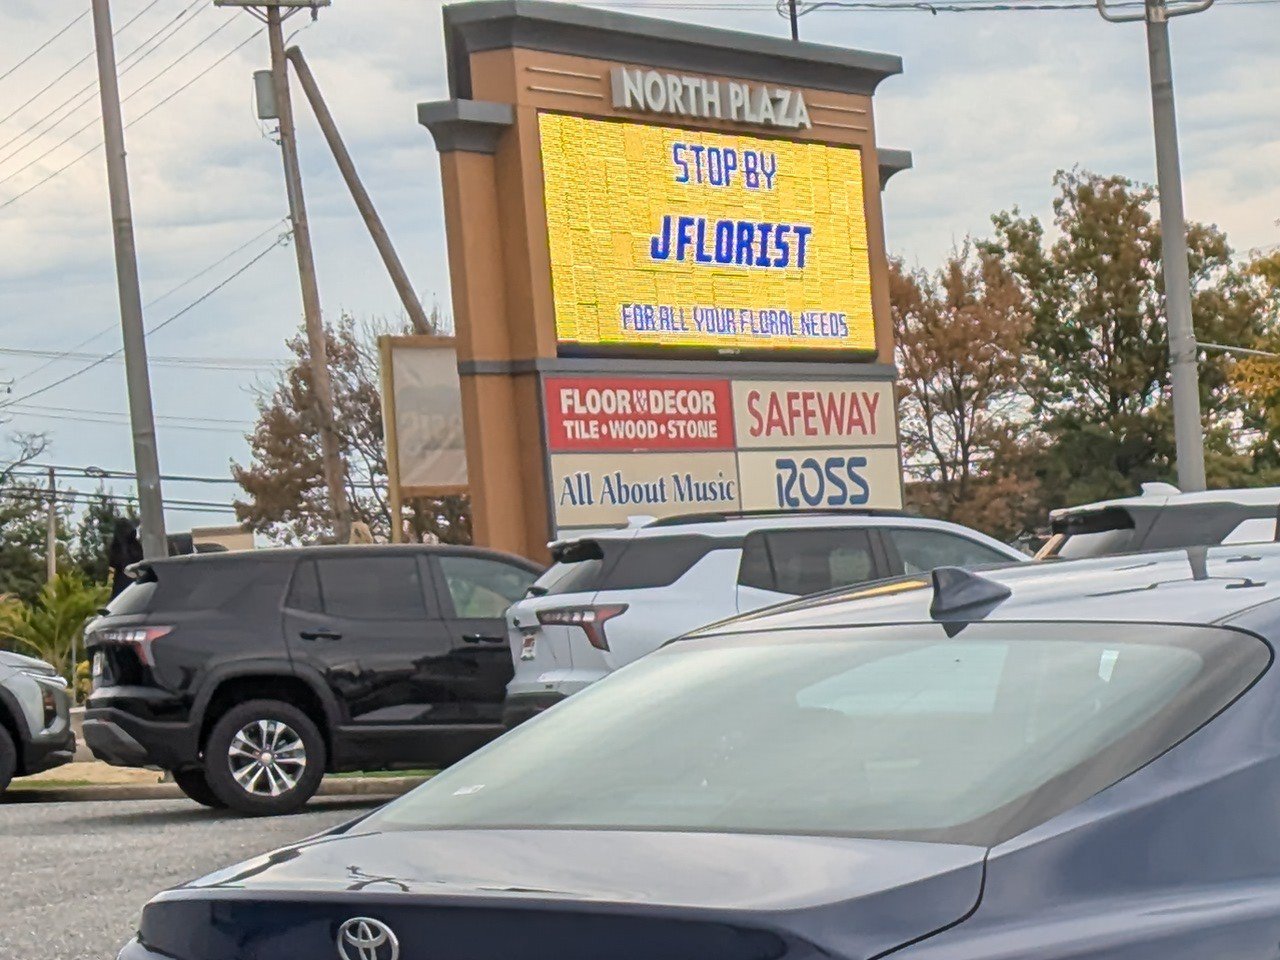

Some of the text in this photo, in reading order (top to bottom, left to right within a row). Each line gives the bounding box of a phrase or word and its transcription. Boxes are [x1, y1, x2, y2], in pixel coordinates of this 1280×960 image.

[612, 67, 812, 129] NORTH PLAZA
[672, 142, 777, 189] STOP BY
[621, 304, 849, 337] FOR ALL YOUR FLORAL NEEDS
[560, 388, 632, 414] FLOOR
[649, 389, 716, 415] DECOR
[747, 390, 881, 438] SAFEWAY
[563, 419, 718, 439] TILE WOOD STONE
[560, 470, 736, 507] All About Music
[775, 456, 870, 508] ROSS
